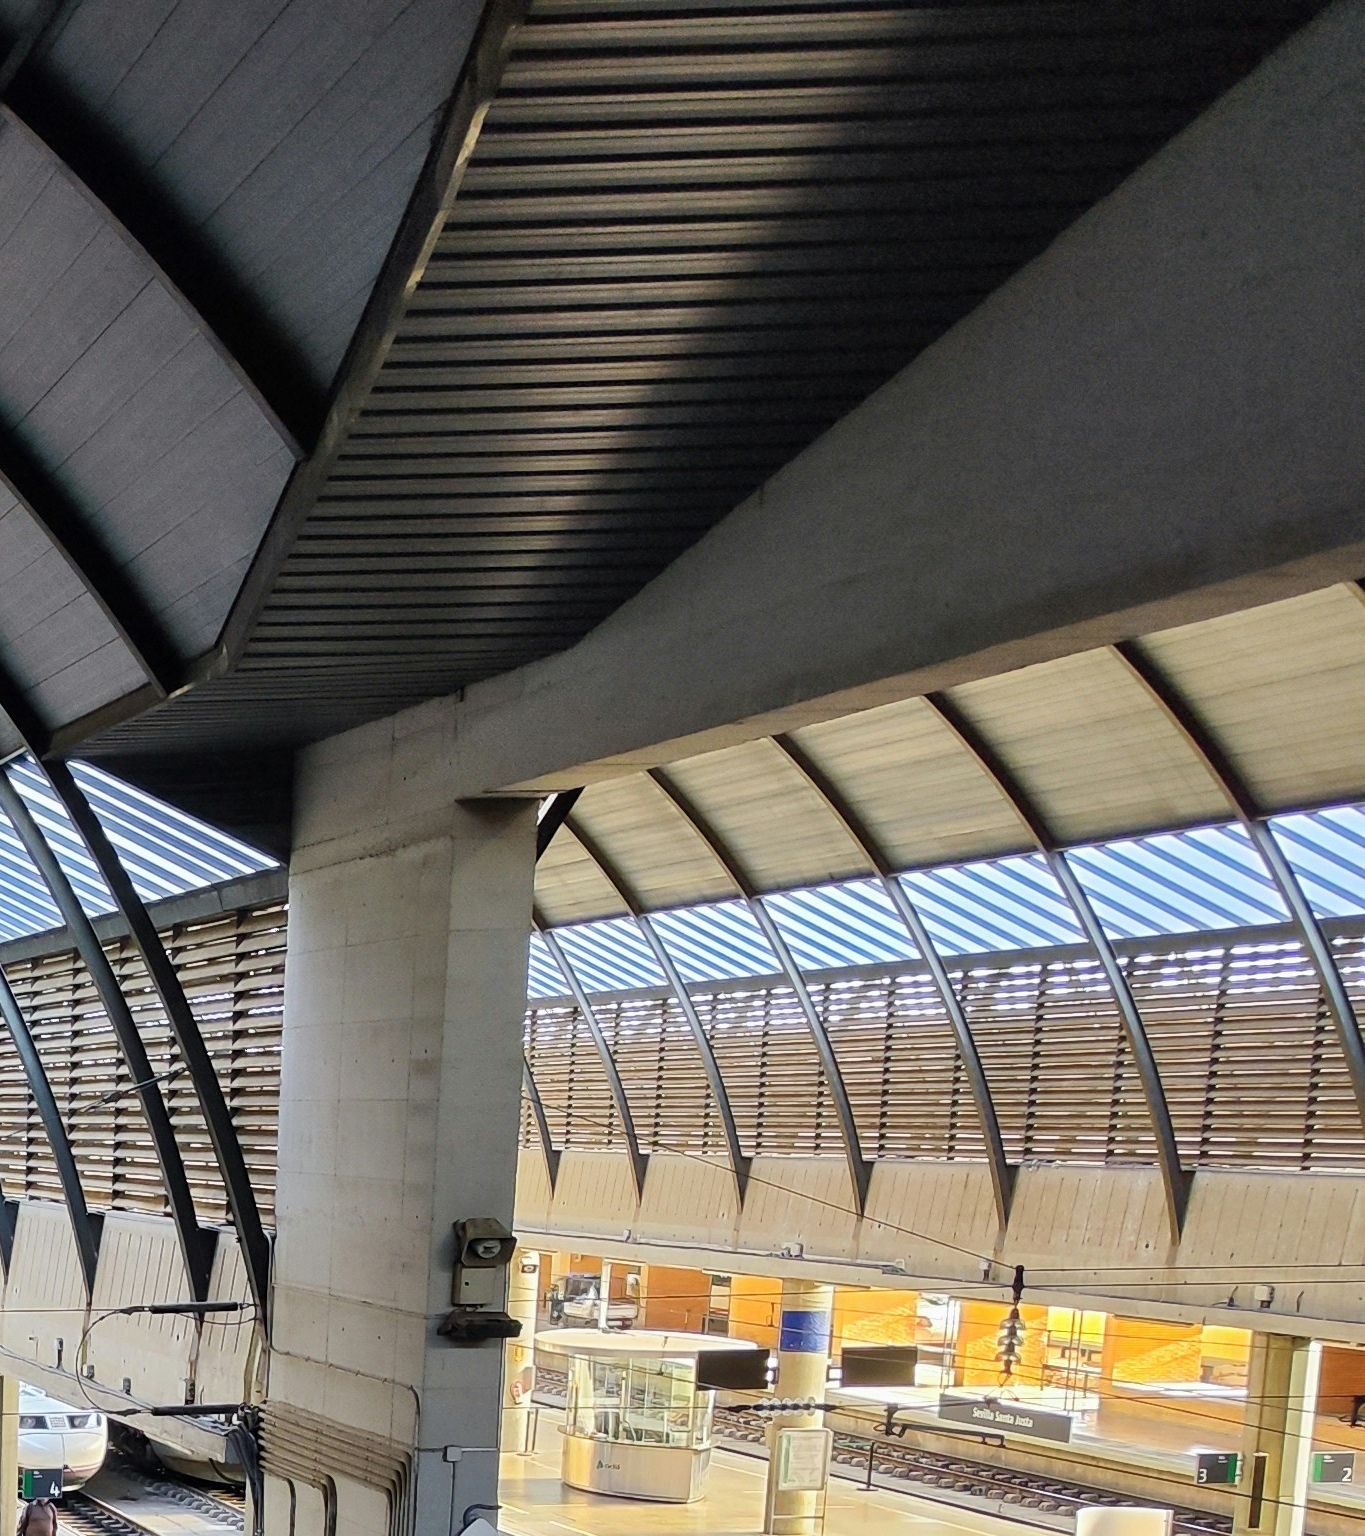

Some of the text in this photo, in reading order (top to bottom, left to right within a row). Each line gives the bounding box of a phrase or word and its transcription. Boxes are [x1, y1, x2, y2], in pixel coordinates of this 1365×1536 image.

[972, 1407, 1033, 1427] Sevilla Santa Justa
[1198, 1468, 1208, 1483] 3
[1341, 1467, 1353, 1482] 2
[49, 1480, 61, 1498] 4
